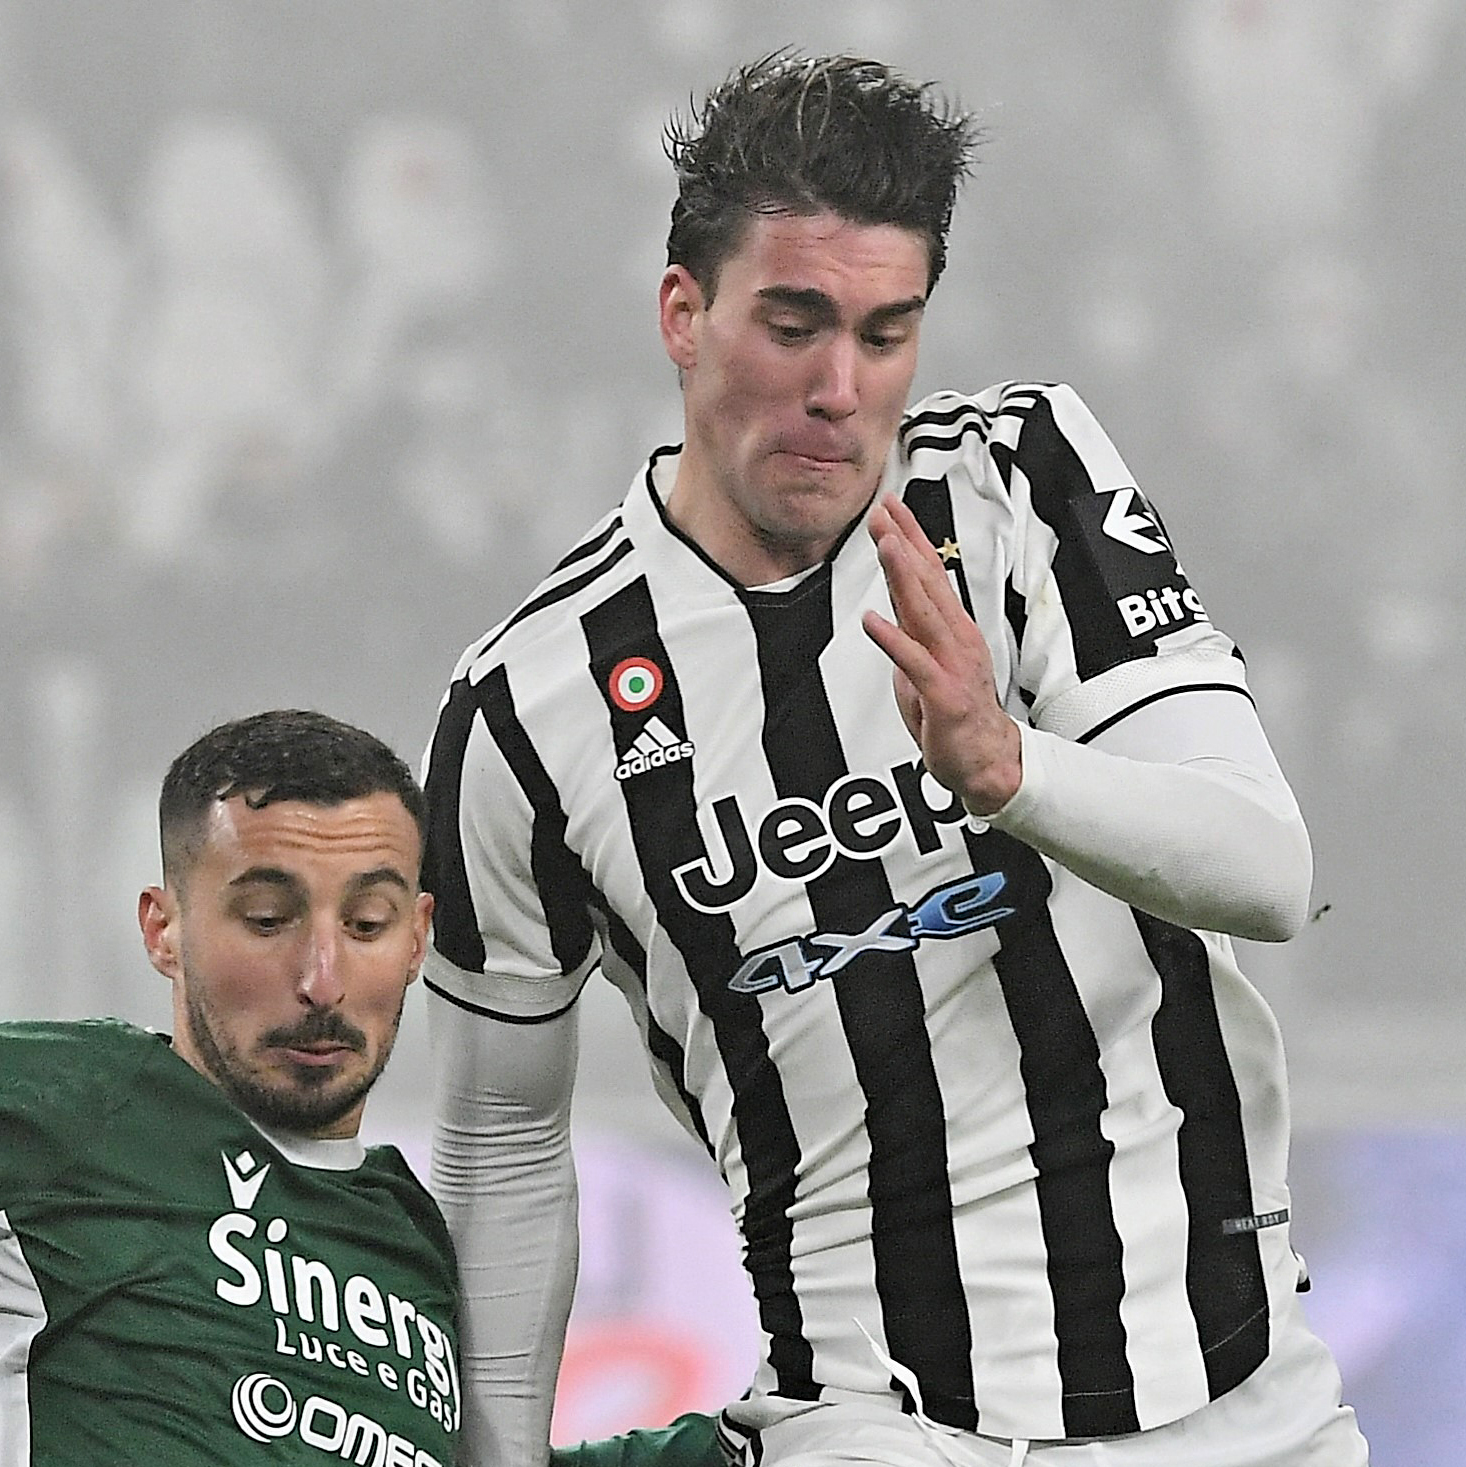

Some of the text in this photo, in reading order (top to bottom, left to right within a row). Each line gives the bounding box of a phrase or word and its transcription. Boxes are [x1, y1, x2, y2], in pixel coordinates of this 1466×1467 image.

[615, 741, 695, 780] adidas
[671, 756, 970, 913] Jeep
[274, 1317, 453, 1434] Luce e Gas
